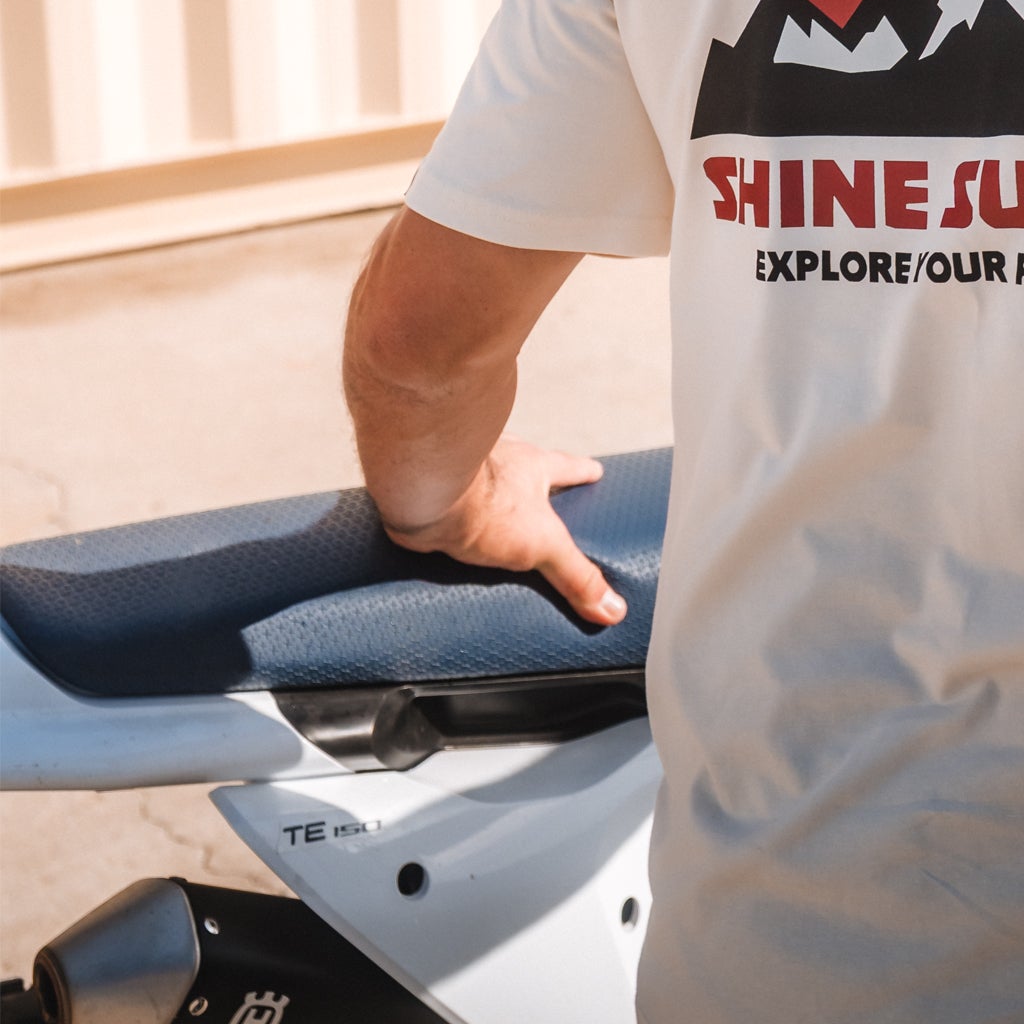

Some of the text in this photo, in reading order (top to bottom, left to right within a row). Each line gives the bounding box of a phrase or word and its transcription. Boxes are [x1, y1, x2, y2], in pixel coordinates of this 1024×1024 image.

[702, 156, 928, 230] SHINE
[756, 249, 912, 285] EXPLORE
[282, 819, 382, 846] TE 150
